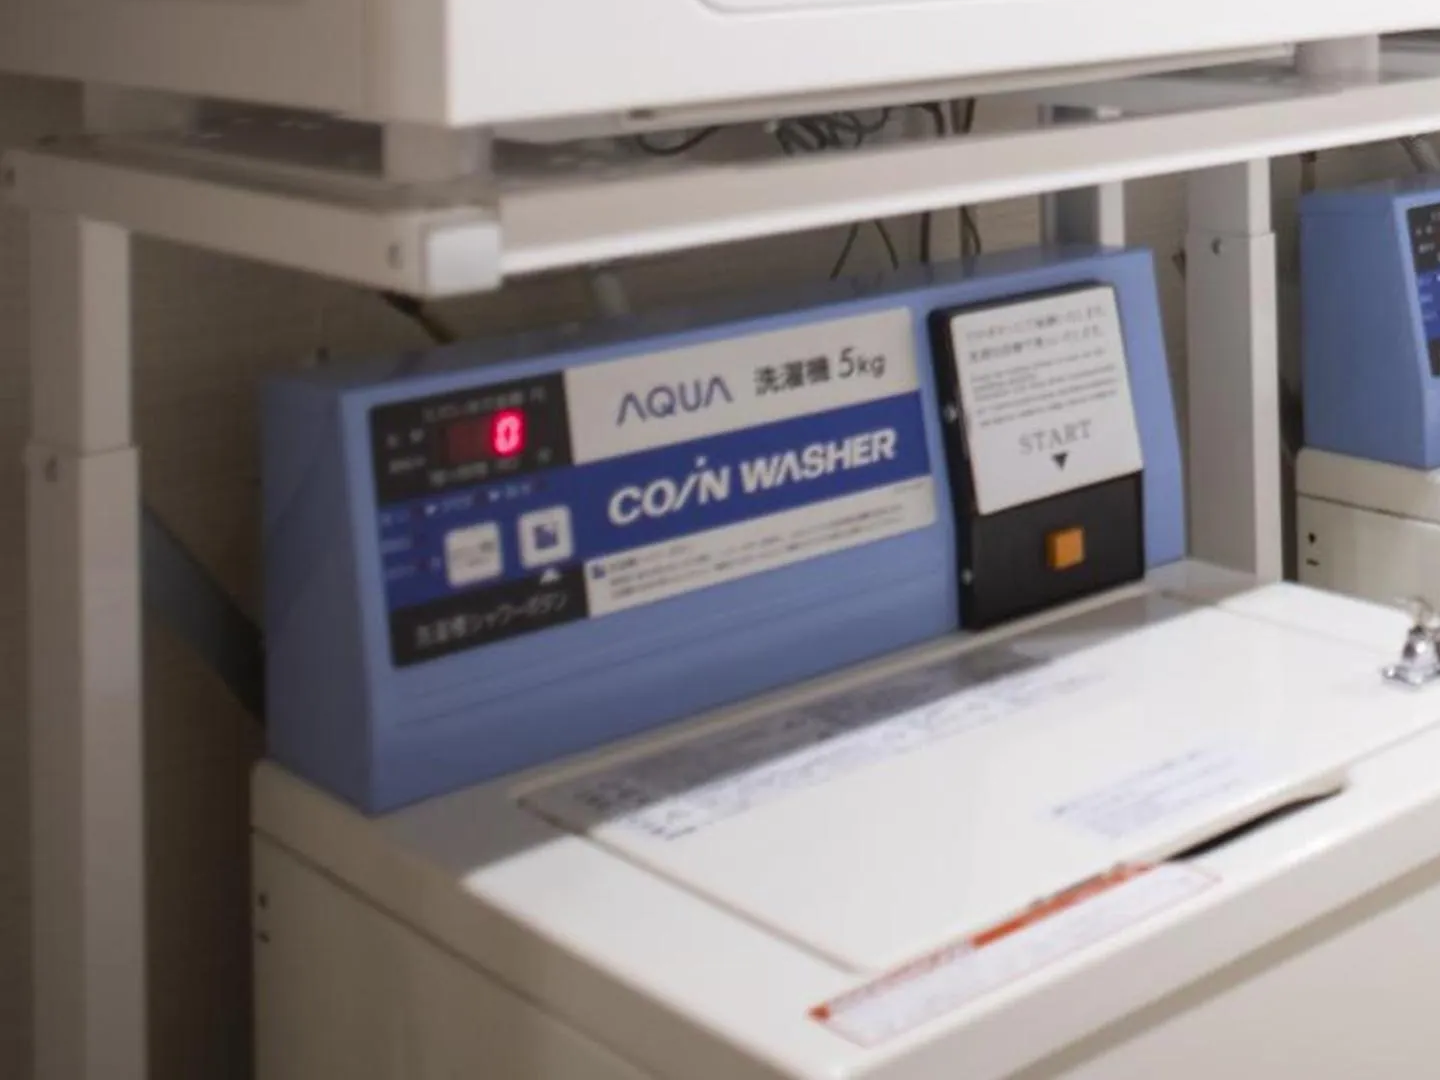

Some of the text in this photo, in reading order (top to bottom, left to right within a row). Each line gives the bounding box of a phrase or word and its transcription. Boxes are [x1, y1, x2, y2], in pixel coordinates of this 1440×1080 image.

[615, 346, 887, 427] AQUA 洗濯機 5kg
[493, 414, 522, 455] 0
[739, 427, 897, 494] WASHER
[1018, 420, 1093, 456] START
